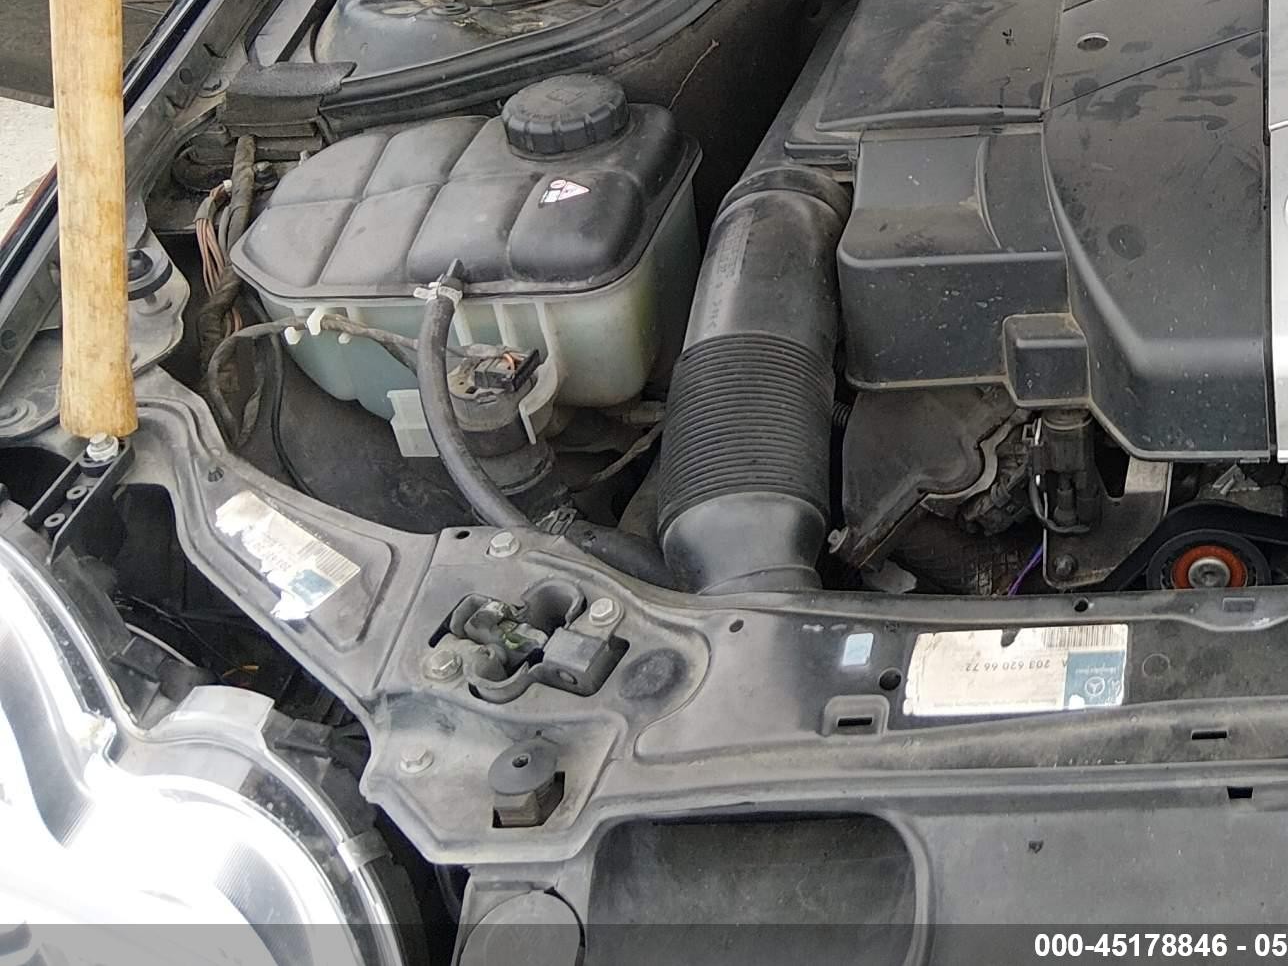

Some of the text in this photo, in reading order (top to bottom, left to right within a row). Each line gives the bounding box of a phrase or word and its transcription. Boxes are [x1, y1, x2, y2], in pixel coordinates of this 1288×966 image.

[965, 662, 980, 672] 72
[984, 662, 1000, 671] 66
[1002, 661, 1025, 671] 620
[1028, 659, 1051, 670] 203
